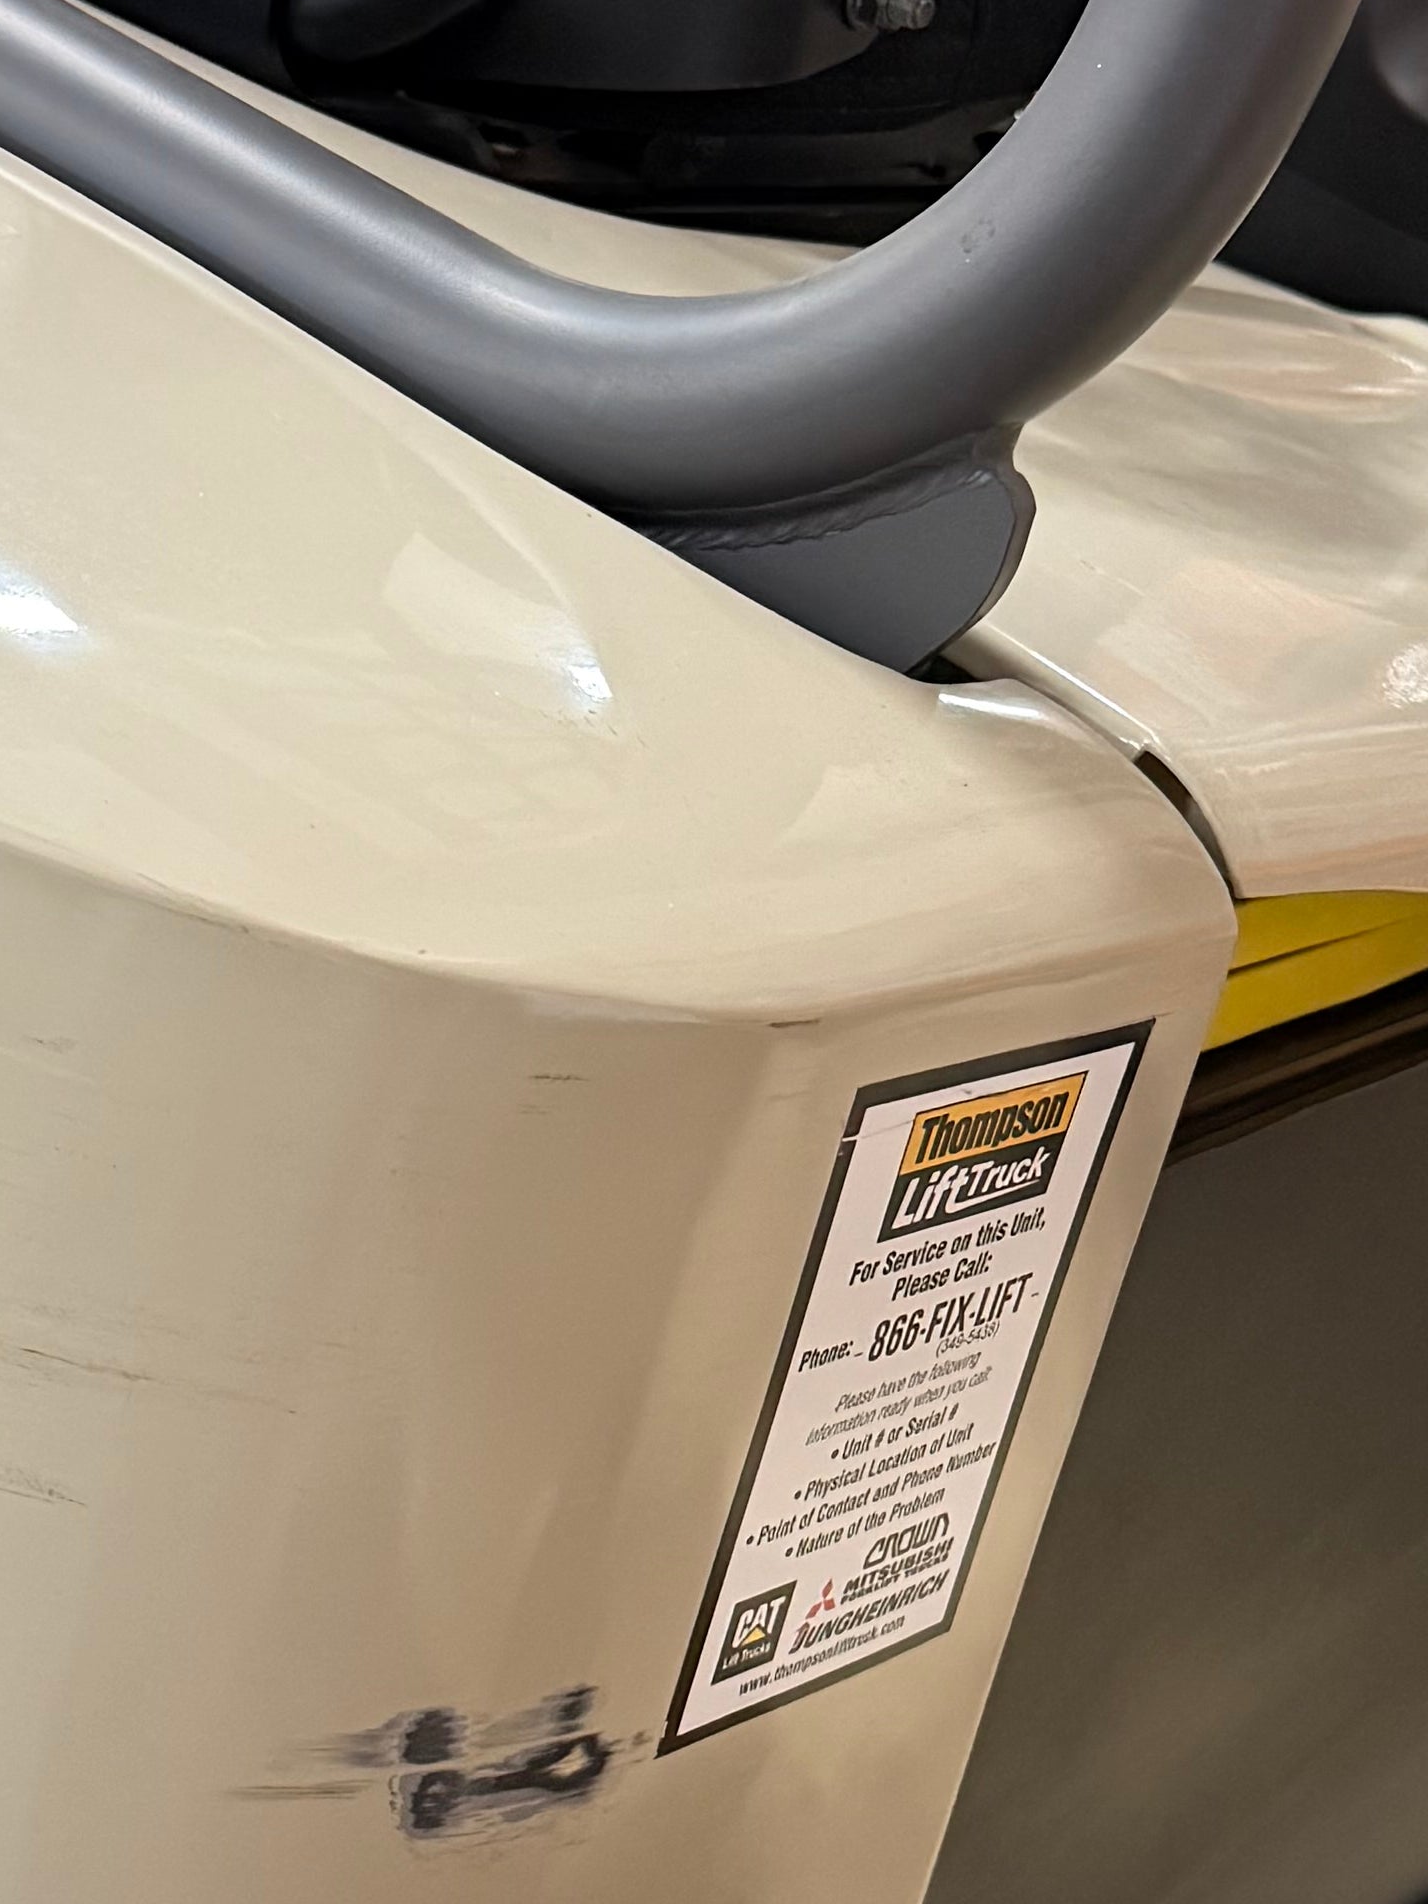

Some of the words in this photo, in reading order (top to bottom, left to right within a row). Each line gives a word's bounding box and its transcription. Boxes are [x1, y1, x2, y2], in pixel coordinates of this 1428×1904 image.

[915, 1091, 1069, 1165] Thompson
[848, 1260, 881, 1286] For
[882, 1241, 948, 1276] Service
[950, 1234, 972, 1254] on
[976, 1219, 1009, 1247] this
[1010, 1206, 1046, 1238] Unit,
[891, 1267, 951, 1302] Please
[953, 1250, 993, 1283] Call:
[798, 1340, 854, 1372] Phone:
[868, 1272, 1034, 1362] 866-FIX-LIFT
[935, 1320, 1002, 1358] (349-5438)
[835, 1388, 876, 1413] Please
[877, 1377, 907, 1397] have
[907, 1369, 928, 1388] the
[928, 1352, 982, 1382] following
[877, 1395, 915, 1421] ready
[913, 1385, 946, 1408] when
[943, 1378, 968, 1400] you
[804, 1466, 865, 1501] Physical
[868, 1443, 927, 1478] Location
[929, 1435, 944, 1459] of
[946, 1422, 975, 1449] Unit
[842, 1430, 873, 1460] Unit
[874, 1428, 886, 1447] #
[887, 1426, 903, 1443] or
[905, 1409, 946, 1438] Serial
[947, 1402, 960, 1421] #
[757, 1518, 798, 1546] Point
[799, 1511, 814, 1531] of
[816, 1487, 872, 1524] Contact
[872, 1478, 900, 1503] and
[901, 1462, 944, 1493] Phone
[945, 1441, 998, 1474] Number
[796, 1526, 844, 1558] Nature
[846, 1518, 863, 1539] of
[864, 1510, 887, 1535] the
[888, 1487, 947, 1524] Problem
[843, 1536, 955, 1595] MITSUBISHI
[862, 1512, 951, 1570] CROWN
[732, 1596, 787, 1649] CAT
[788, 1568, 951, 1655] JUNGHEINRICH
